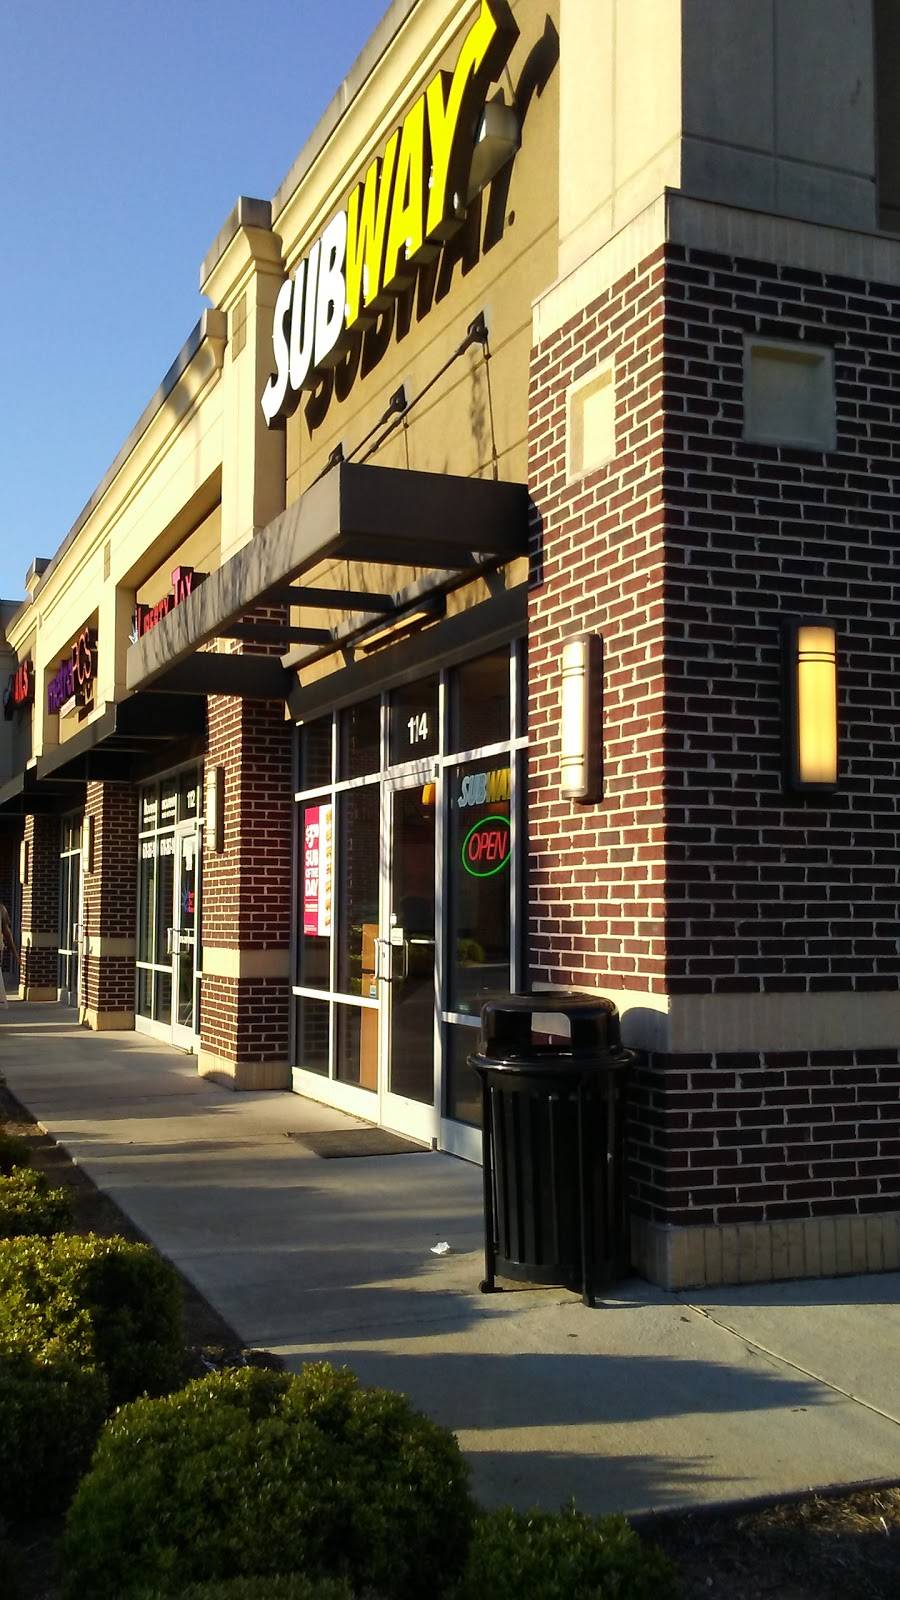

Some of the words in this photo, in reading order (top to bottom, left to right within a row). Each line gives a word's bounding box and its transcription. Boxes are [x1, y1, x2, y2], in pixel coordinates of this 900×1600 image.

[261, 0, 497, 427] SUBWAY
[407, 711, 429, 745] 114
[468, 830, 509, 862] OPEN
[305, 878, 319, 897] DAY
